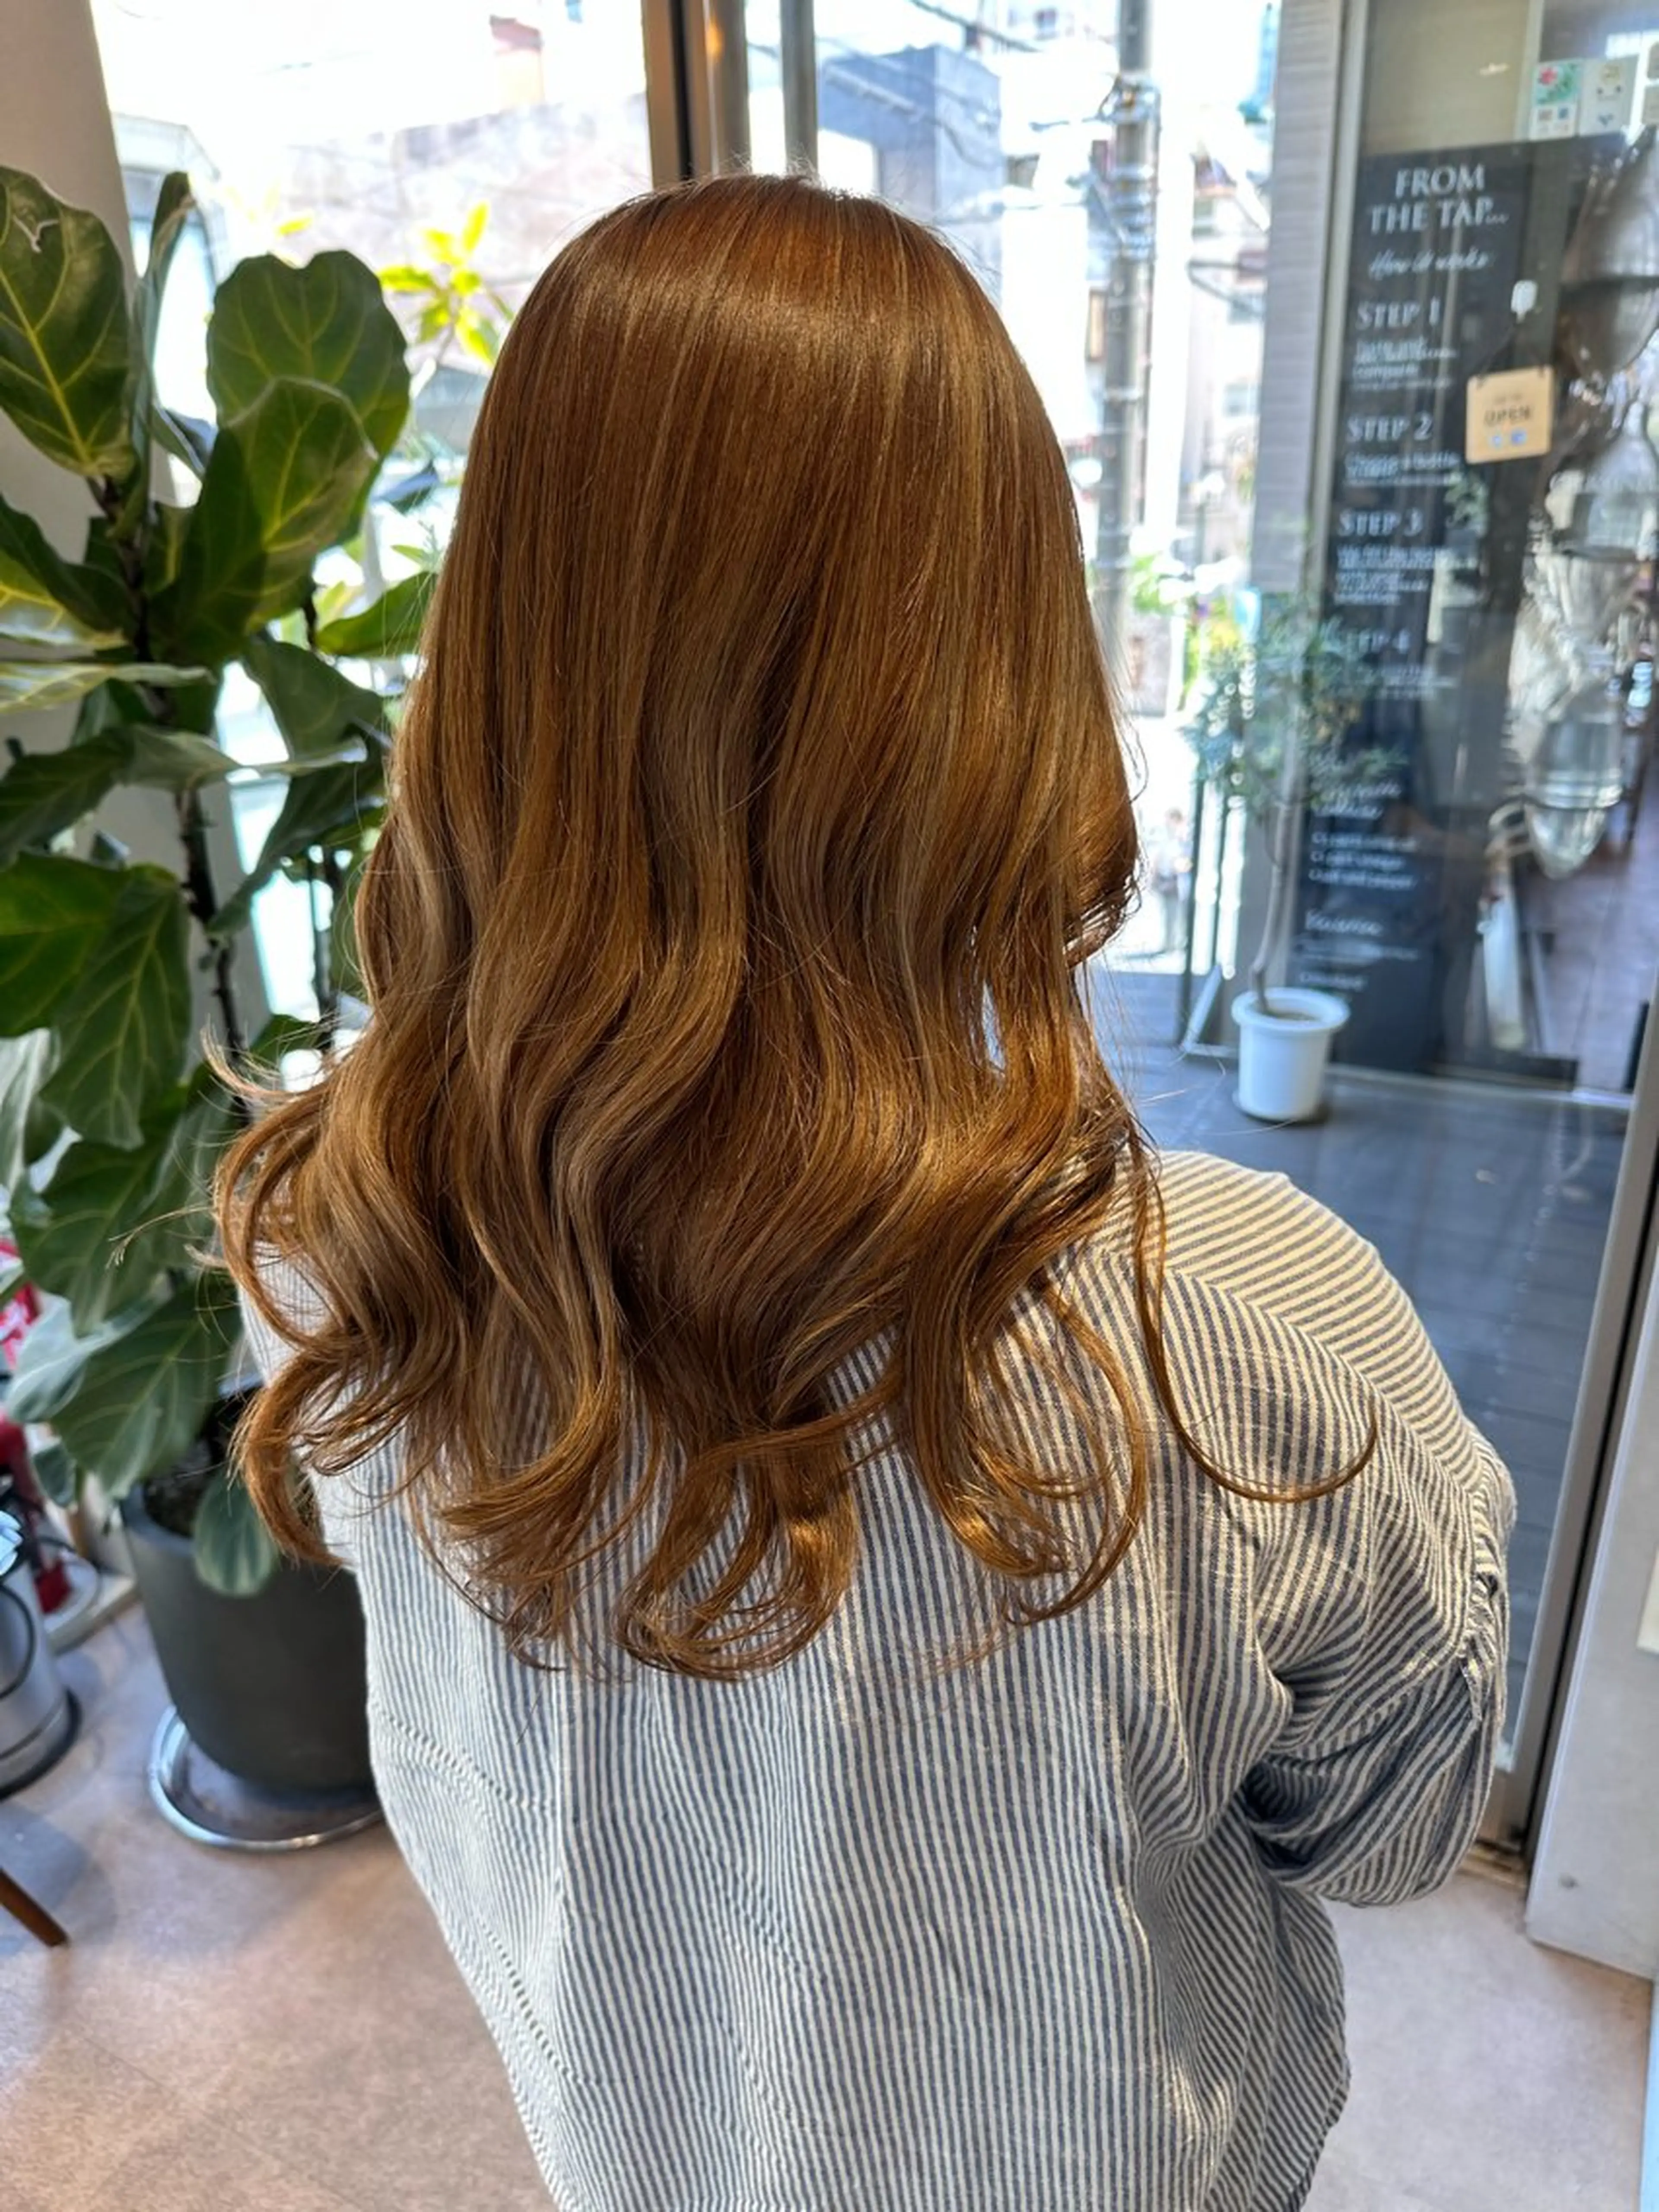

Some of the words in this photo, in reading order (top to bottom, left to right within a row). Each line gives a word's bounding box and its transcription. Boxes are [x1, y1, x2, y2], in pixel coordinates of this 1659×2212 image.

[1396, 164, 1485, 198] FROM
[1370, 202, 1427, 234] THE
[1356, 301, 1421, 330] STEP
[1429, 296, 1440, 327] 1
[1346, 415, 1410, 443] STEP
[1413, 412, 1433, 441] 2
[1483, 406, 1532, 428] OPEN
[1338, 509, 1402, 537] STEP
